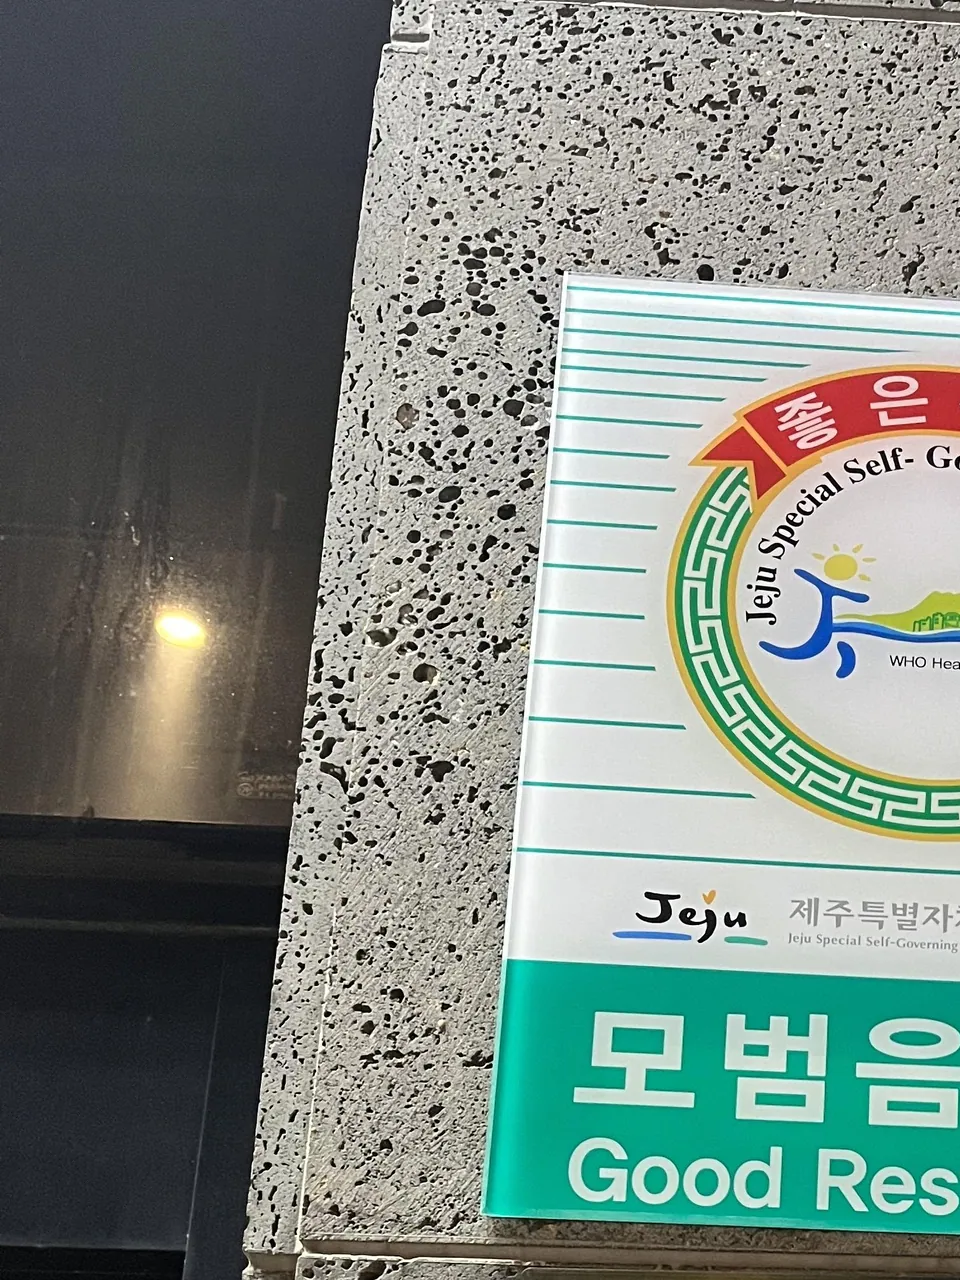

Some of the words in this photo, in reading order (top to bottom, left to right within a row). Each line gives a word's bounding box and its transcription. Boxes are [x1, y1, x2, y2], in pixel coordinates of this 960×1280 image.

[843, 447, 914, 485] Self-
[758, 472, 844, 560] Special
[746, 566, 782, 626] Jeju
[889, 654, 927, 668] WHO
[635, 889, 748, 944] Jeju
[788, 932, 812, 945] Jeju
[815, 933, 862, 948] Special
[866, 936, 959, 954] Self-Governing
[567, 1136, 784, 1210] Good
